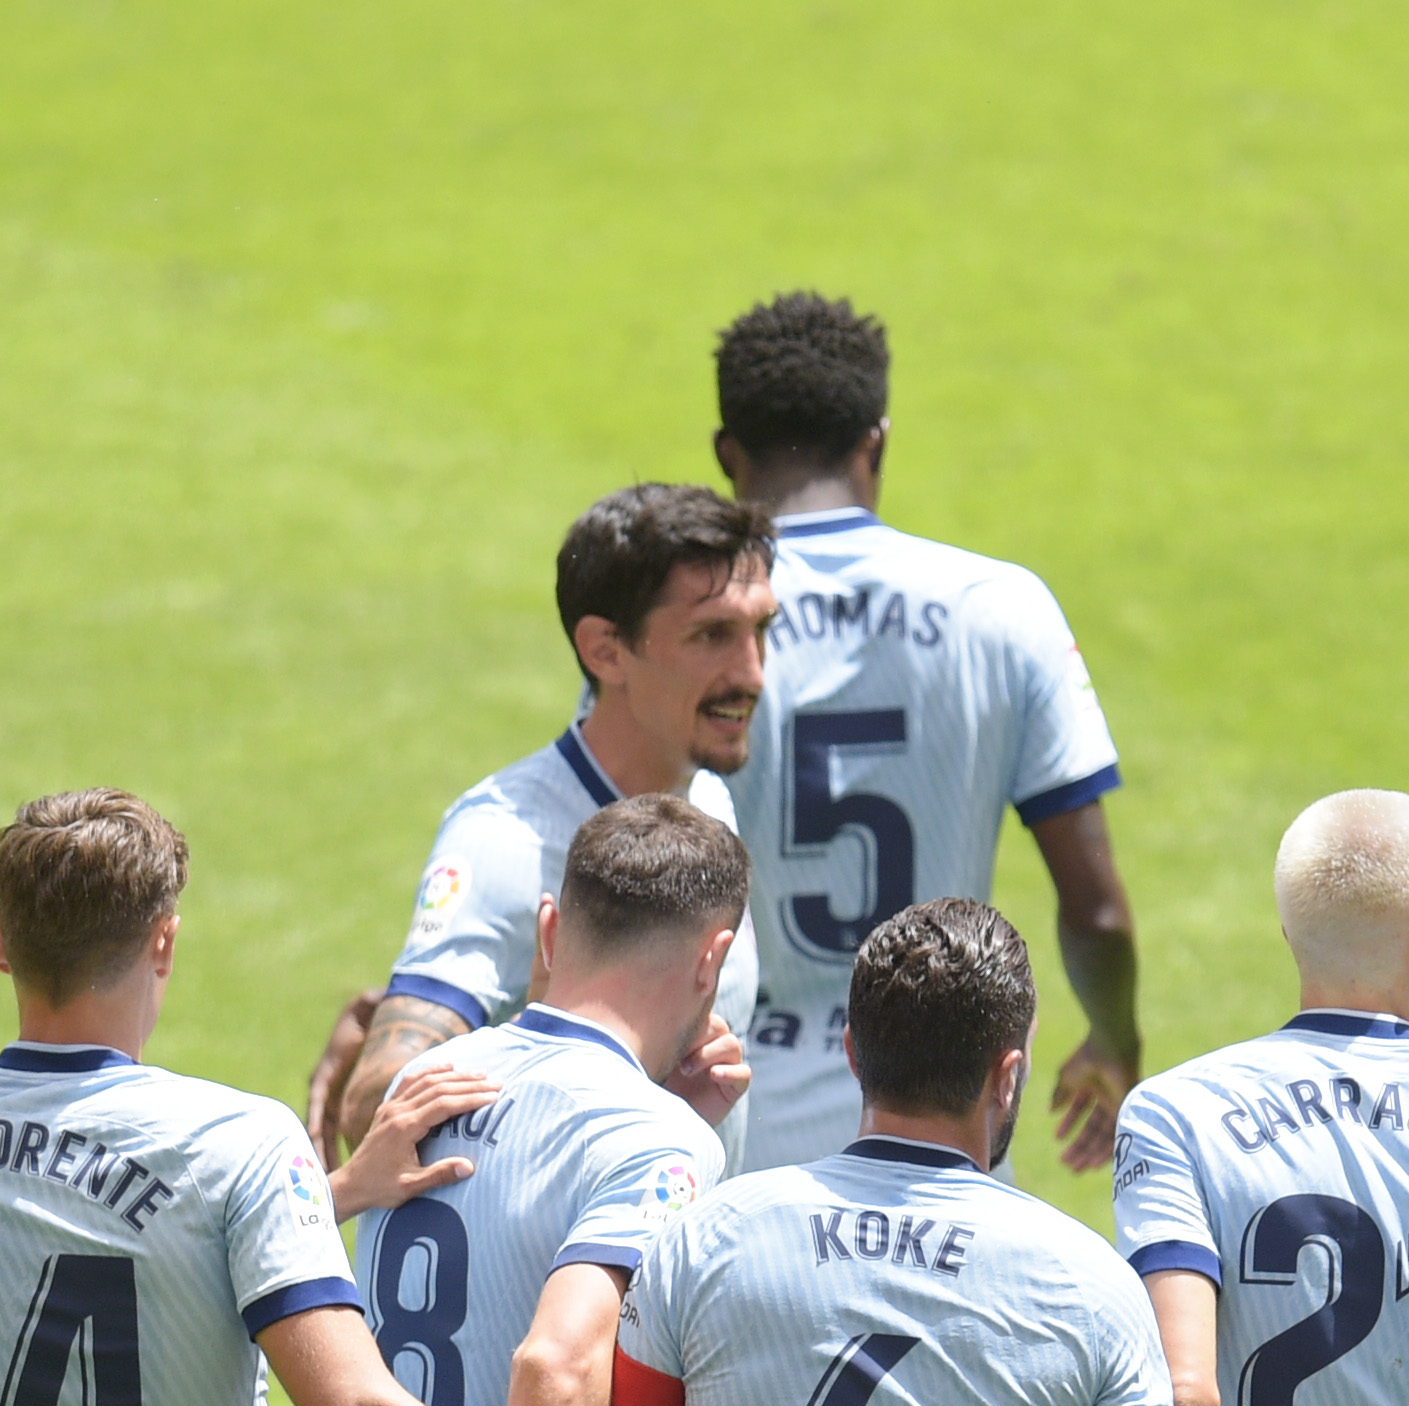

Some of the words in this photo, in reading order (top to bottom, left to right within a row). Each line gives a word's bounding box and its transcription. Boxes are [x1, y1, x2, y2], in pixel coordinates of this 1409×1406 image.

[767, 591, 949, 650] HOMAS
[780, 708, 915, 966] 5
[809, 1210, 976, 1279] KOKE
